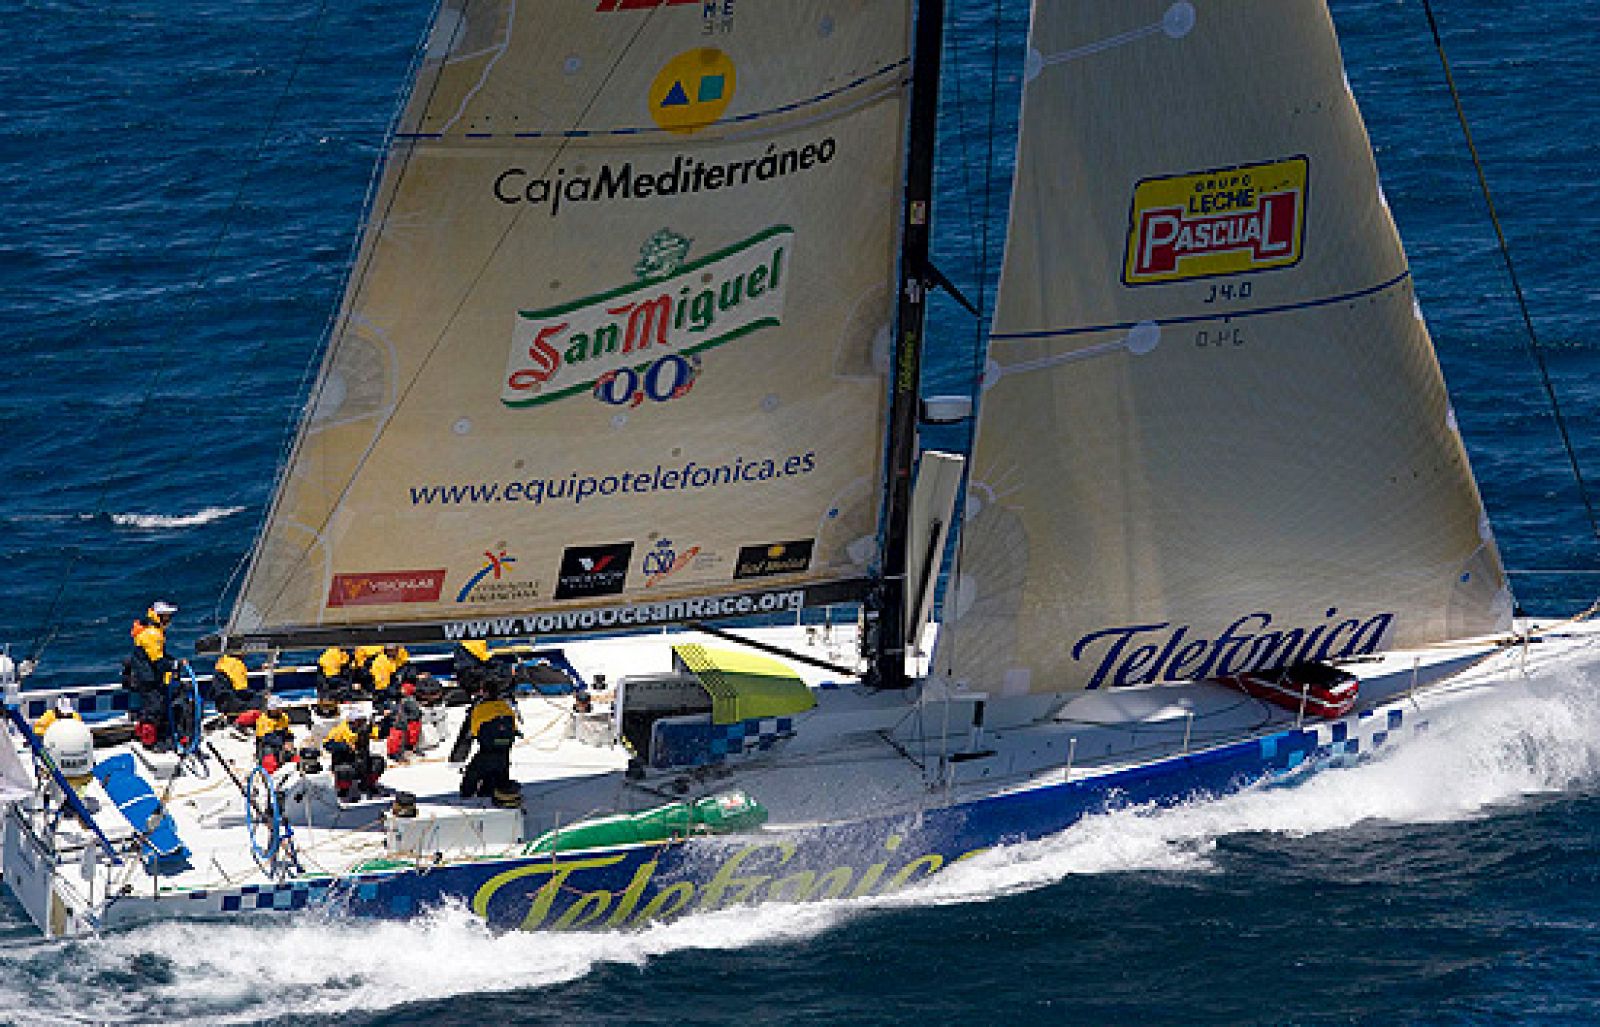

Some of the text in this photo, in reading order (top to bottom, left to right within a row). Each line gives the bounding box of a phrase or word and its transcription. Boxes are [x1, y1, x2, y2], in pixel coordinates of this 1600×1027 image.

[1189, 188, 1255, 214] LECHE
[1142, 201, 1288, 269] PASCUAL
[409, 449, 817, 506] www.equipotelefonica.es
